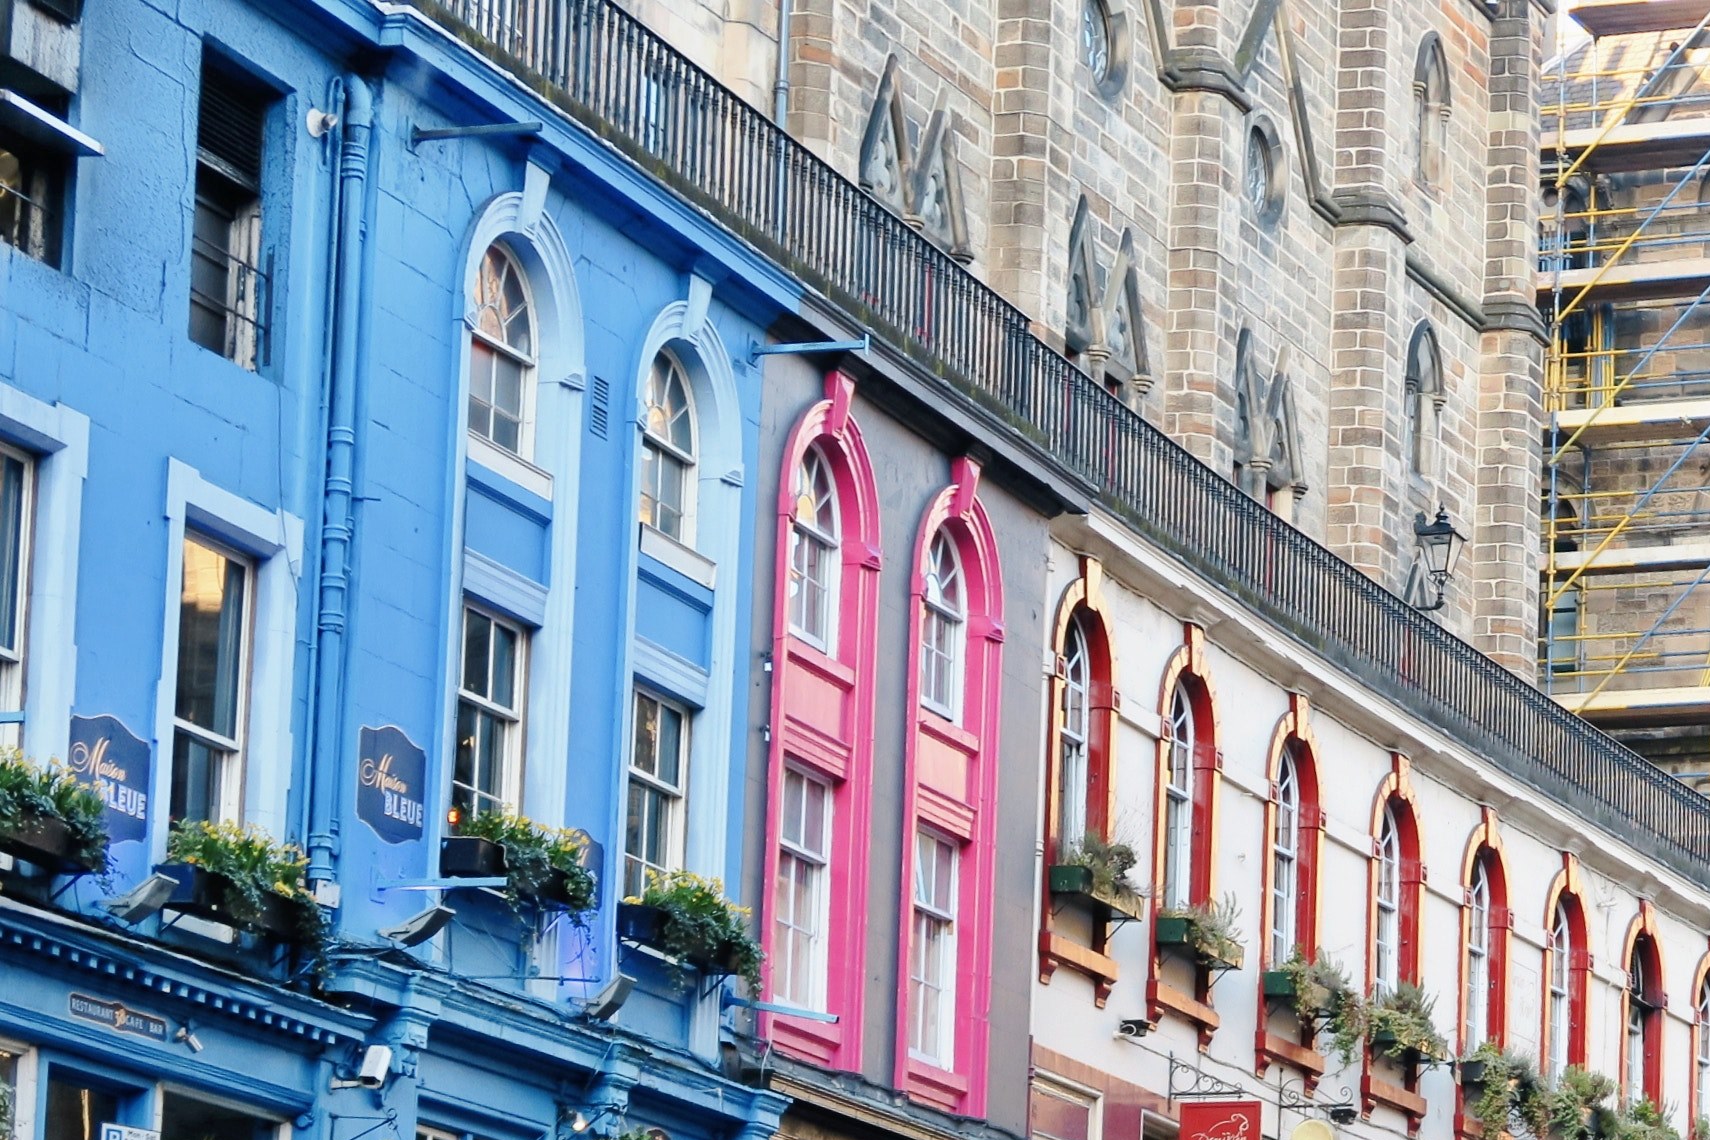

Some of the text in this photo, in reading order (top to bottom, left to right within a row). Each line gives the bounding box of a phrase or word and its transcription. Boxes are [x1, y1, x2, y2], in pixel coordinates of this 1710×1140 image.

[384, 790, 423, 828] BLEUE
[127, 1129, 141, 1139] Mon
[146, 1131, 157, 1140] Sat
